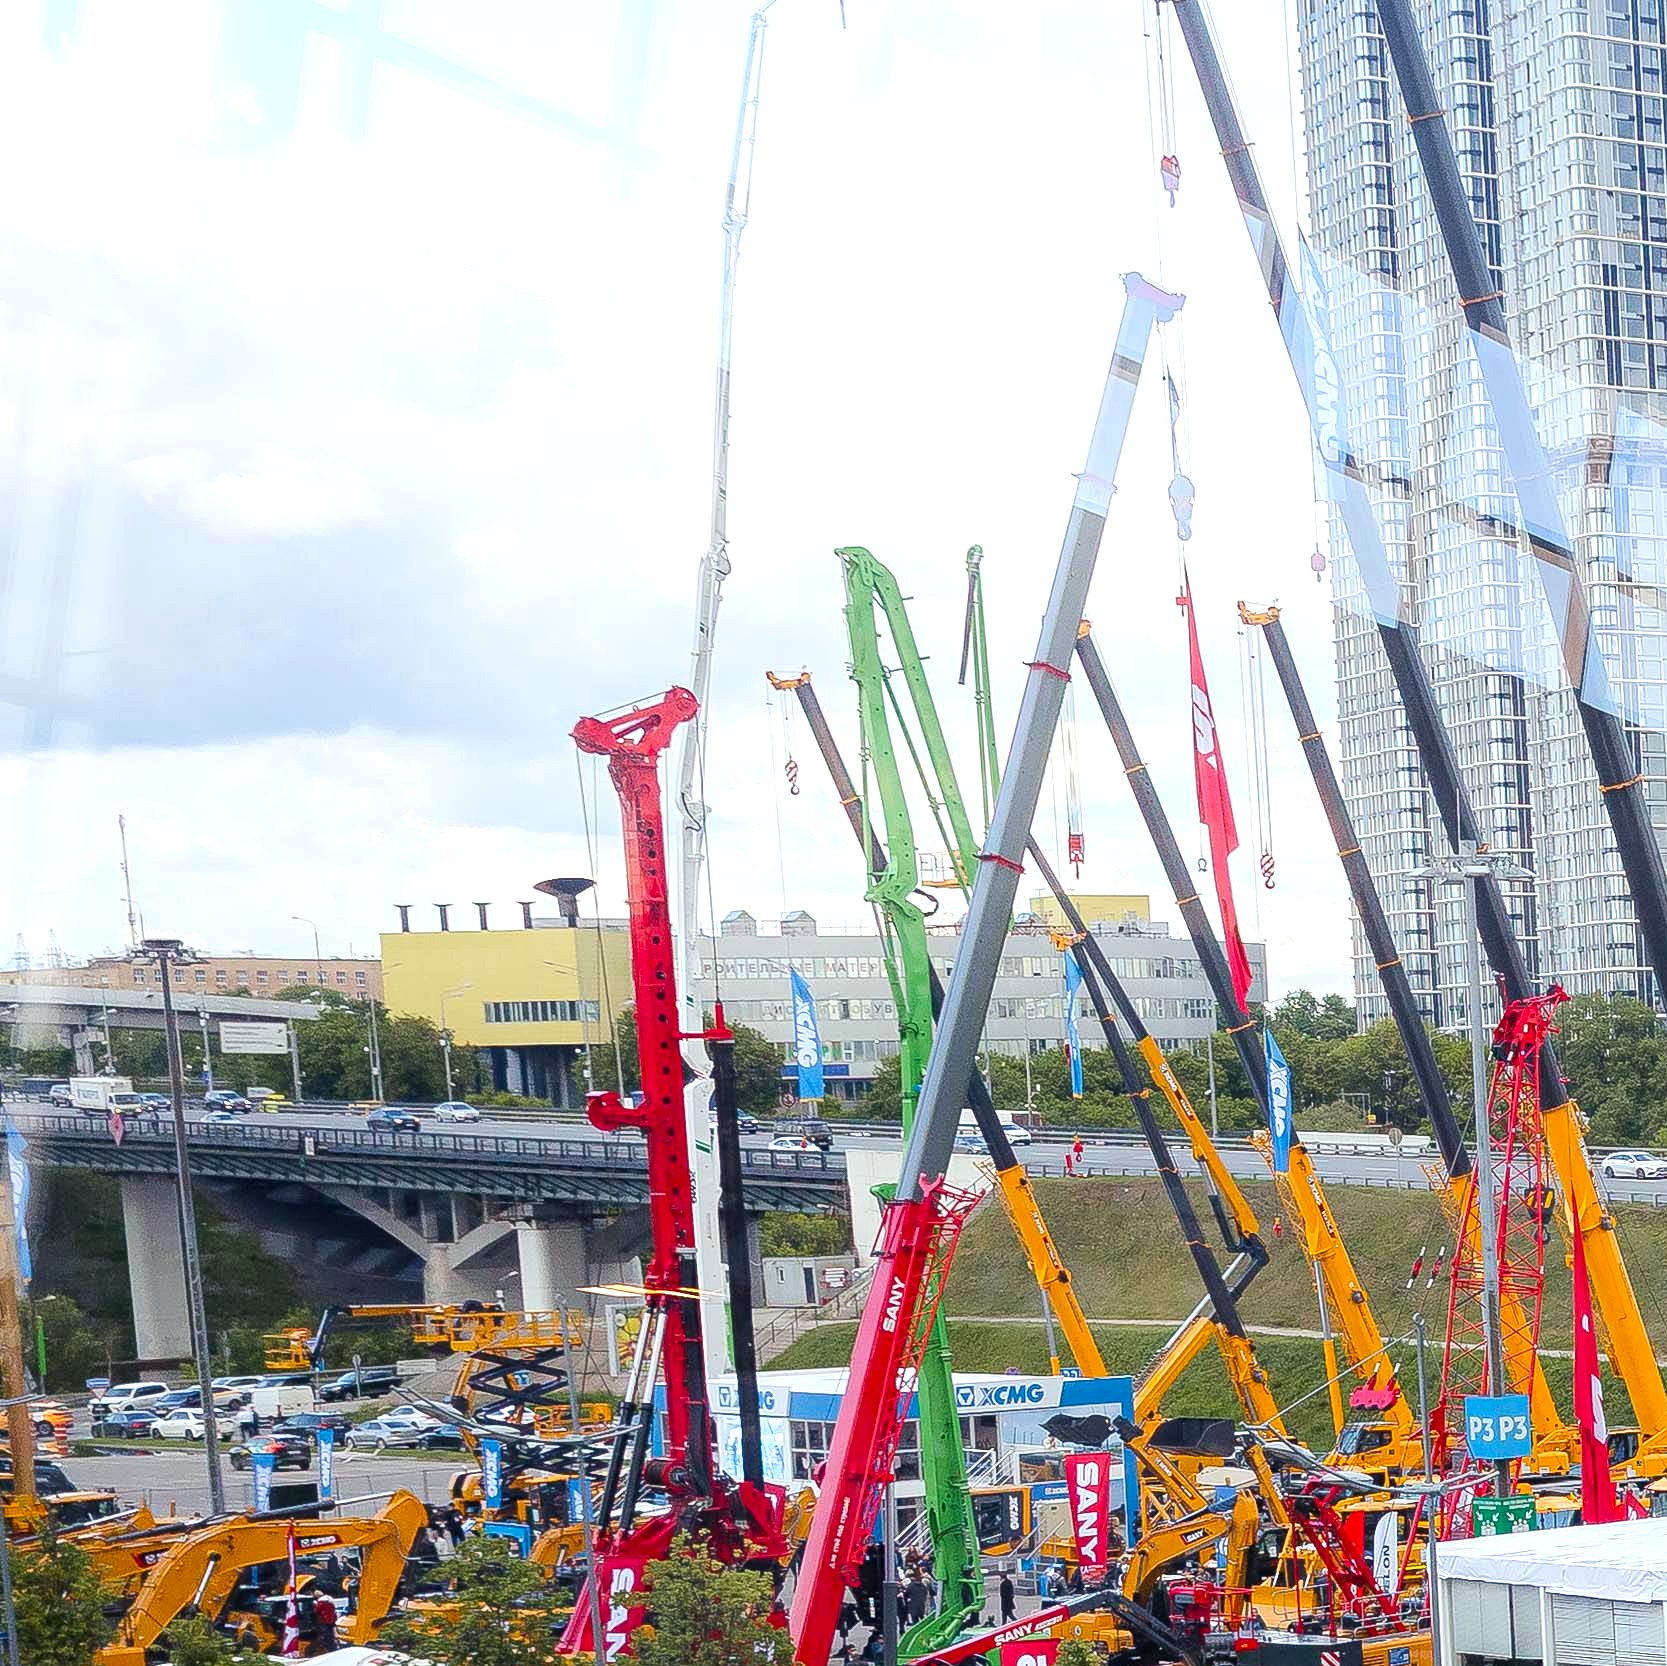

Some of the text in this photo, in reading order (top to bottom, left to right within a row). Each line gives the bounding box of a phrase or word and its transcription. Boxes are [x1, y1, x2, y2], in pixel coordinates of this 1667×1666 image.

[793, 994, 817, 1070] XCMG
[883, 1276, 906, 1333] SANY
[976, 1383, 1044, 1408] XCMG
[1470, 1415, 1494, 1442] P3
[1500, 1415, 1527, 1442] P3
[1076, 1460, 1099, 1563] SANY
[994, 1622, 1033, 1646] SANY
